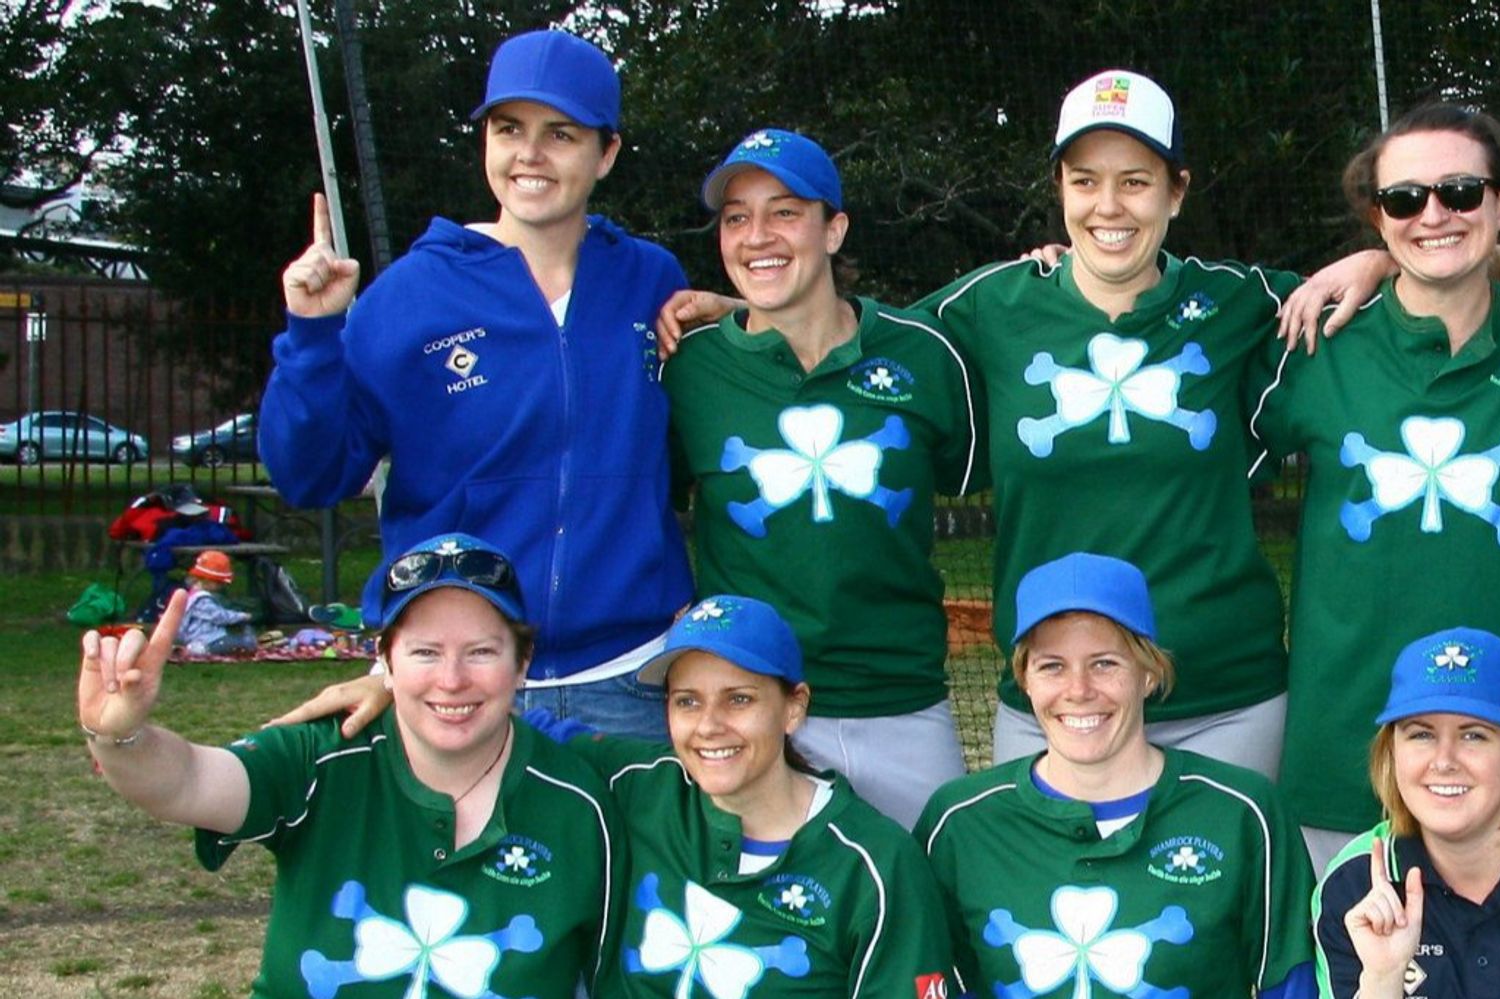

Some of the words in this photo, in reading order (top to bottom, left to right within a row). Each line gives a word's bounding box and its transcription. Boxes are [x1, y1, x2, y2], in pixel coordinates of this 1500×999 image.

[423, 326, 487, 355] COOPER'S
[453, 353, 470, 370] C
[446, 374, 489, 395] HOTEL
